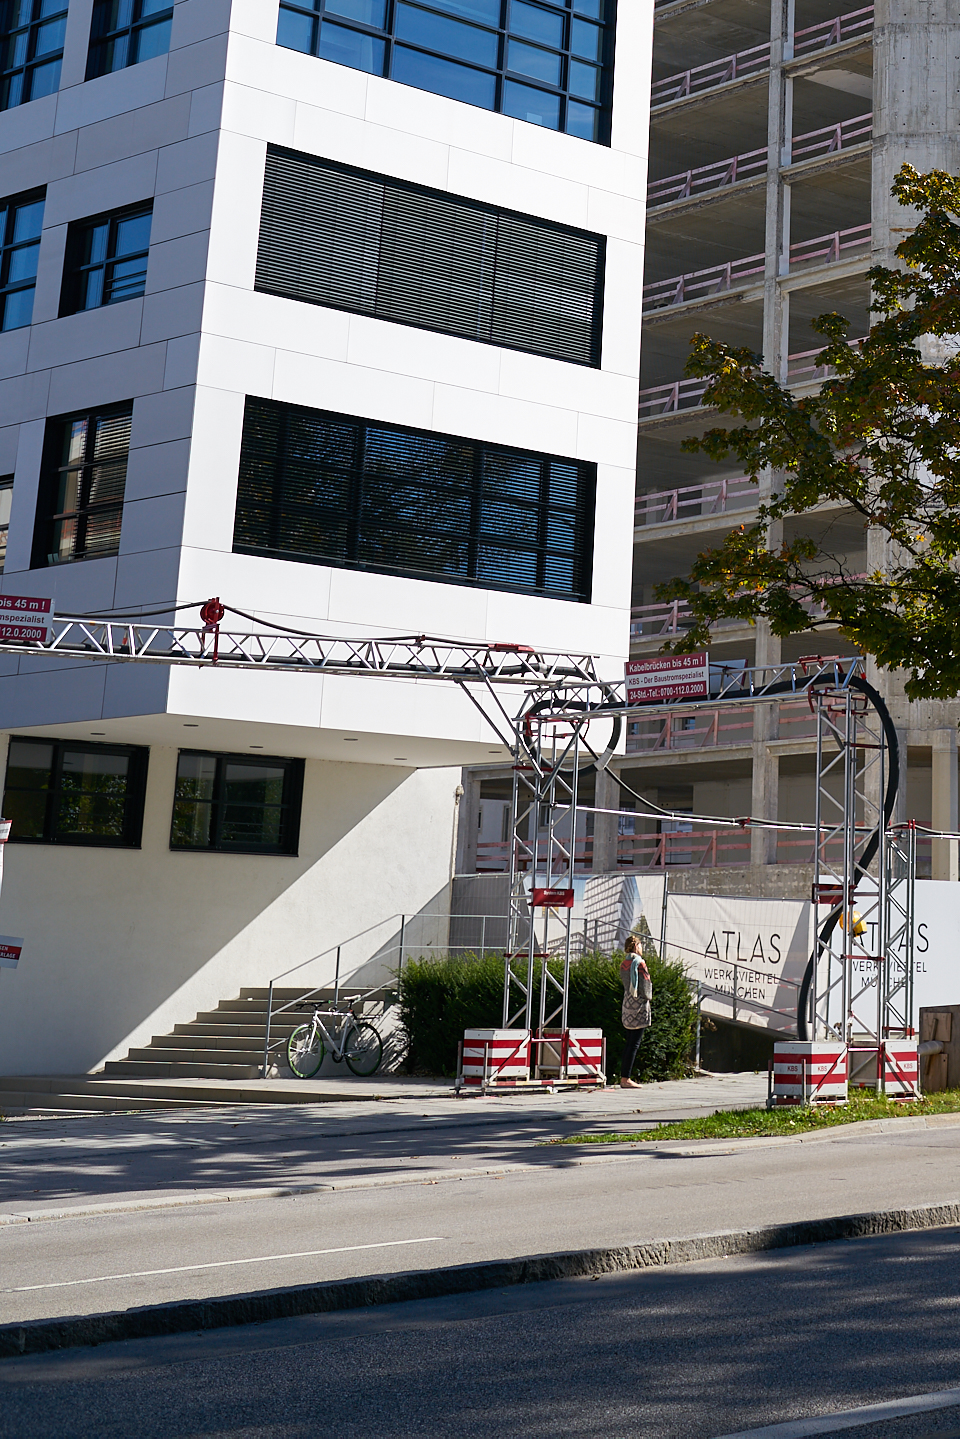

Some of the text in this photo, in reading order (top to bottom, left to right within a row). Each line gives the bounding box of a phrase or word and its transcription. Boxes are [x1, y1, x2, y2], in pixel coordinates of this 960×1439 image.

[15, 599, 27, 608] 45
[0, 627, 42, 638] 12.0.2000
[629, 661, 671, 673] Kabelbrücken
[672, 659, 682, 668] bis
[683, 658, 692, 666] 45
[629, 677, 640, 686] KBS
[644, 676, 653, 684] Der
[654, 671, 704, 682] Baustromspezialist
[704, 930, 781, 964] ATLAS
